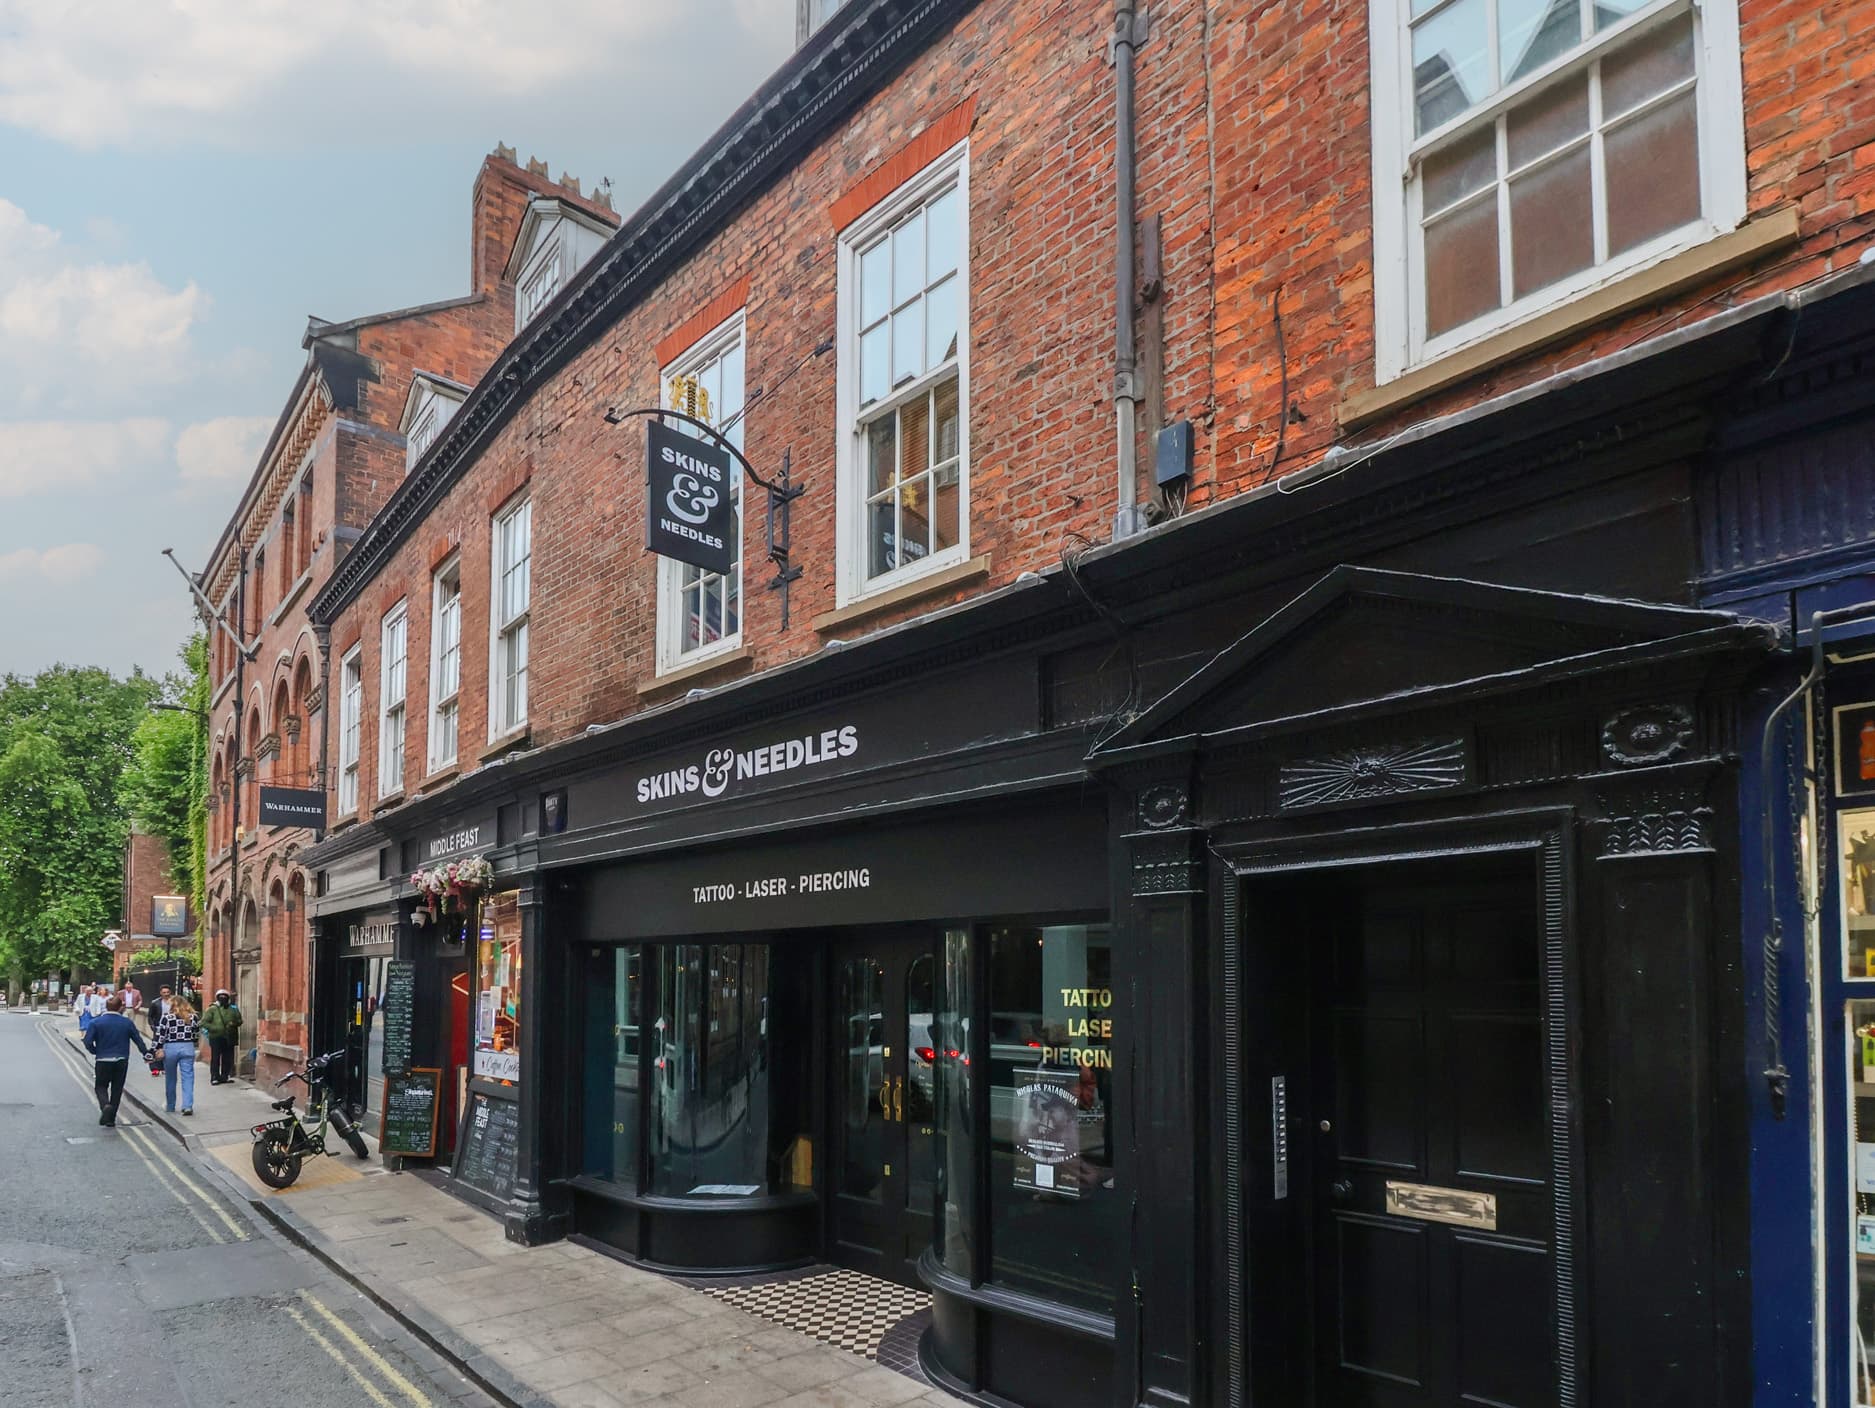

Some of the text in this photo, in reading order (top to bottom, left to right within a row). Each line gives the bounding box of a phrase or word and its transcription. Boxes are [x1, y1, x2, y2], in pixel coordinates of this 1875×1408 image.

[660, 446, 722, 483] SKINS
[665, 473, 719, 524] &
[660, 518, 723, 549] NEEDLES
[637, 725, 858, 803] SKINS & NEEDLES
[430, 826, 479, 857] MIDDLE FEAST
[693, 883, 735, 903] TATTOO
[745, 877, 787, 898] LASER
[799, 868, 870, 893] PIERCING
